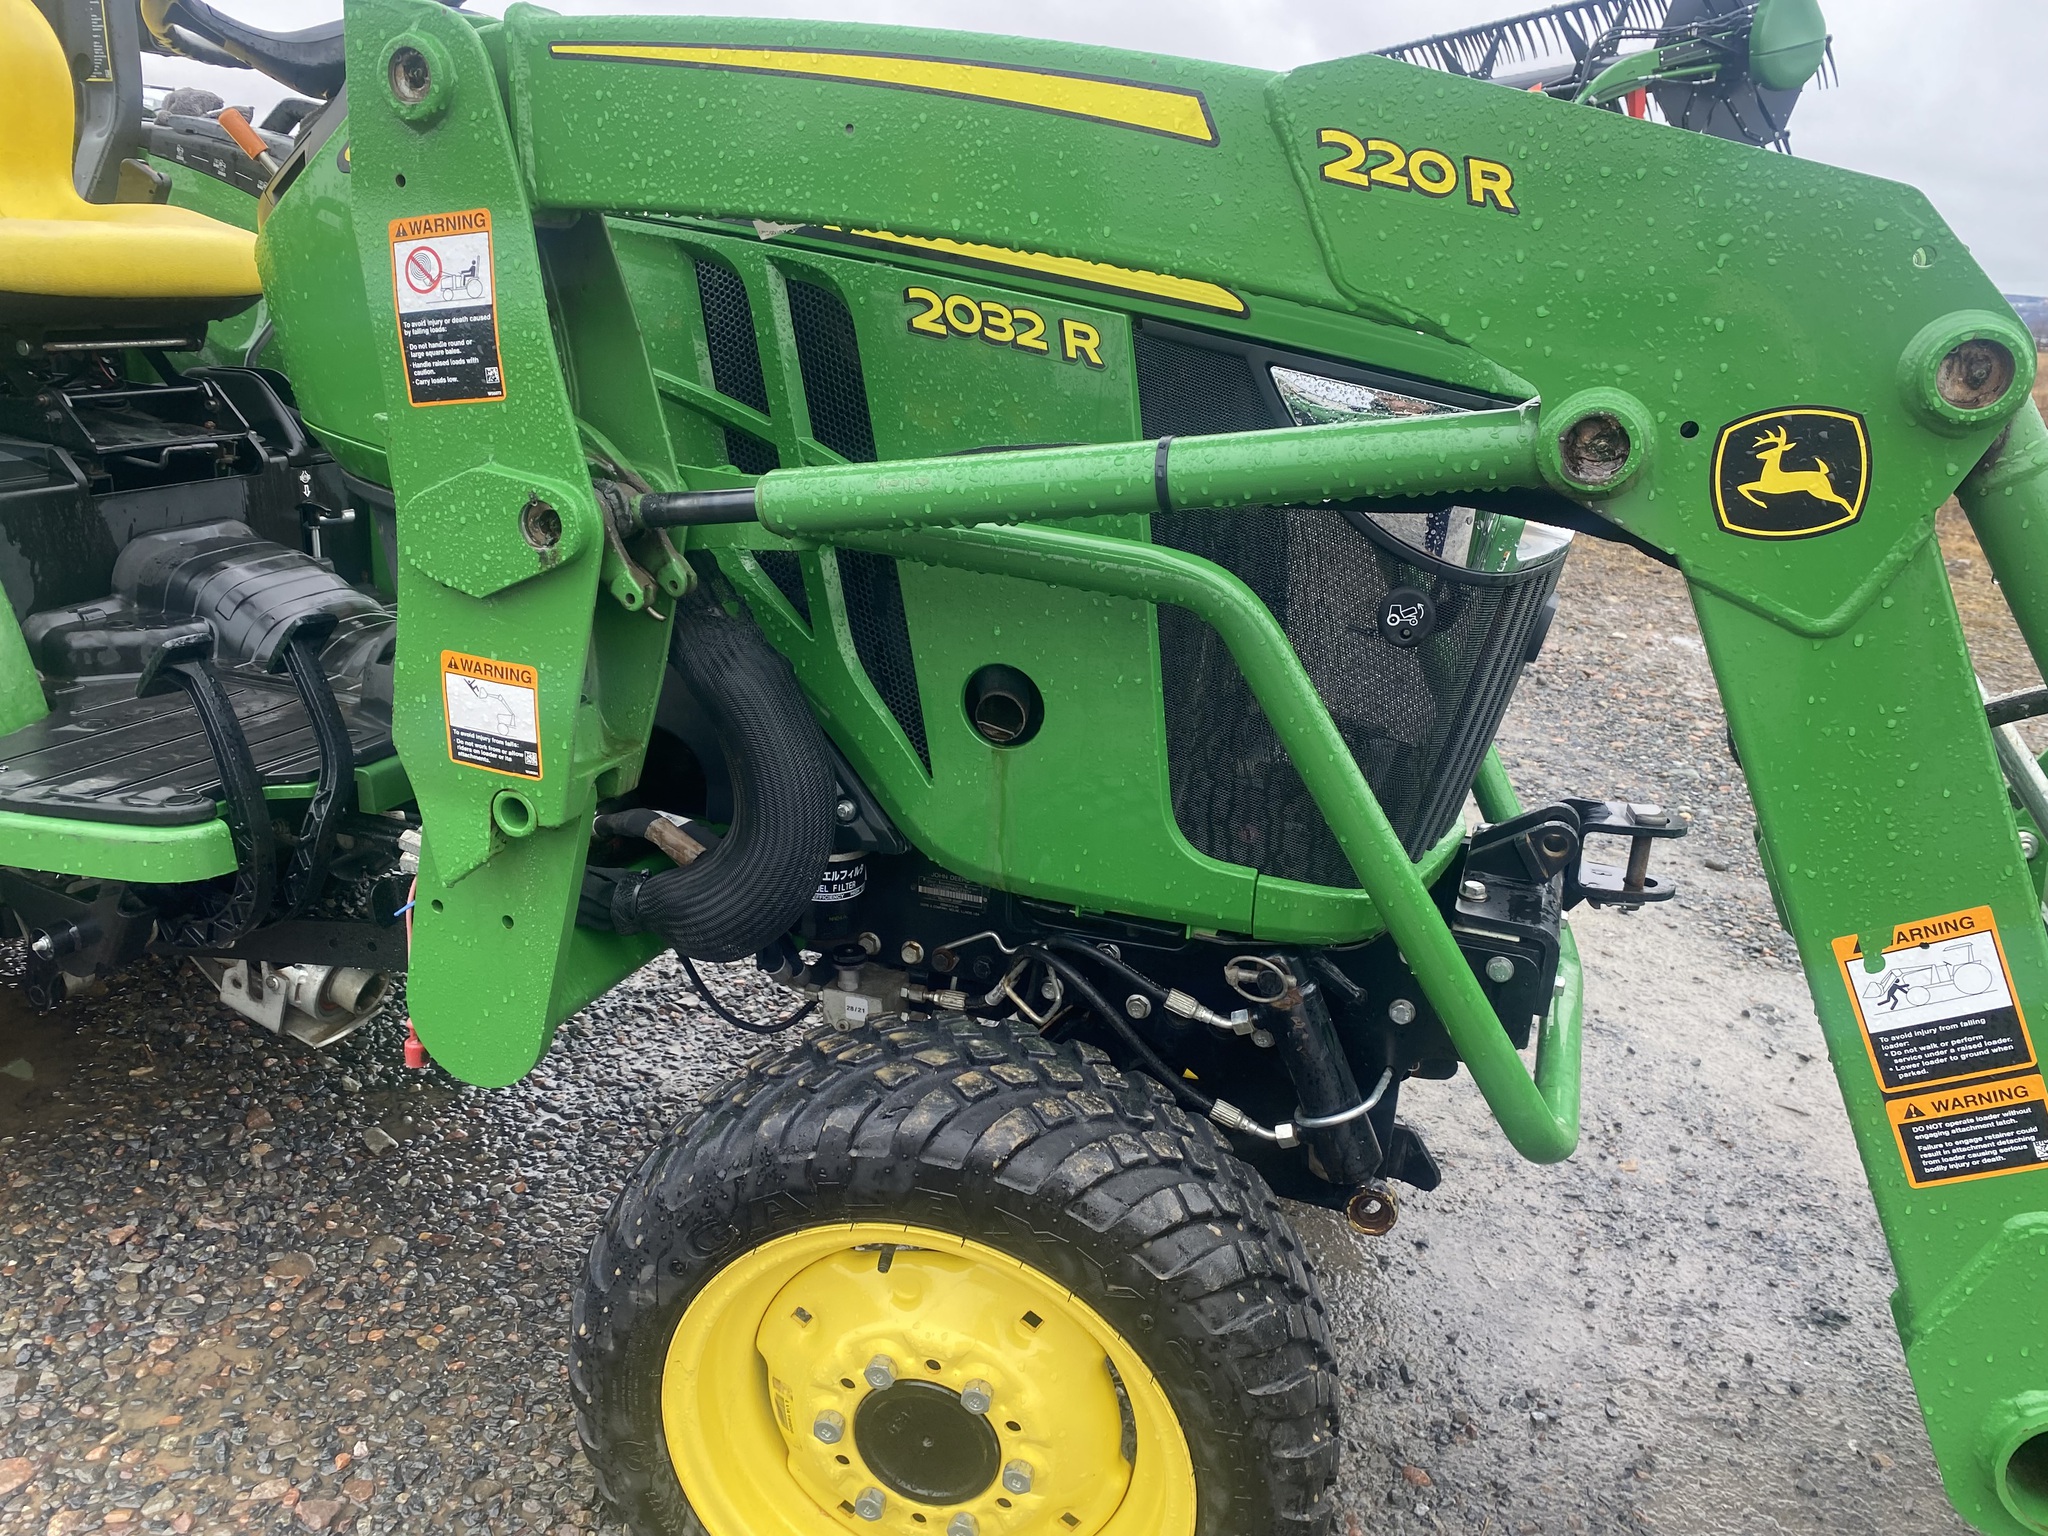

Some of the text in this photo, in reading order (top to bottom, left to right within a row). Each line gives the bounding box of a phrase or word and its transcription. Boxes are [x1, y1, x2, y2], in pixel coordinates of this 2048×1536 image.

[1317, 128, 1519, 216] 220 R
[409, 213, 486, 235] WARNING
[411, 319, 426, 327] avoid
[427, 319, 443, 327] injury
[470, 313, 491, 321] caused
[903, 286, 1107, 370] 2032 R
[404, 329, 411, 337] by
[432, 359, 449, 367] raised
[460, 658, 532, 684] WARNING
[460, 731, 475, 739] avoid
[476, 734, 491, 743] injury
[492, 737, 505, 745] from
[488, 745, 501, 753] from
[508, 750, 524, 758] allow
[822, 864, 864, 881] エルフィルタ
[833, 880, 856, 892] FILTER
[1891, 916, 1975, 946] ARNING
[1890, 1031, 1913, 1041] avoid
[1914, 1028, 1937, 1037] injury
[1938, 1024, 1959, 1032] from
[1960, 1018, 1986, 1028] falling
[1881, 1041, 1910, 1051] loader:
[1893, 1054, 1923, 1064] service
[1924, 1048, 1948, 1058] under
[1956, 1042, 1983, 1052] raised
[1984, 1037, 2013, 1046] loader.
[1903, 1046, 1918, 1054] not
[1919, 1043, 1939, 1051] walk
[1950, 1034, 1984, 1047] perform
[1895, 1062, 1920, 1071] Lower
[1921, 1057, 1948, 1066] loader
[1959, 1048, 1990, 1060] ground
[1990, 1044, 2014, 1053] when
[1898, 1068, 1929, 1080] parked.
[1931, 1085, 2029, 1113] WARNING
[1911, 1107, 2032, 1133] DO NOT operate loader without
[1914, 1118, 2018, 1140] engaging attachment latch.
[1917, 1143, 1944, 1152] Failure
[1954, 1136, 1984, 1145] engage
[1984, 1131, 2015, 1140] retainer
[2016, 1126, 2038, 1135] could
[1920, 1149, 1943, 1159] result
[1951, 1141, 1996, 1154] attachment
[1996, 1135, 2036, 1146] detaching
[1922, 1145, 2028, 1166] from loader causing serious
[1924, 1164, 1948, 1173] bodily
[1948, 1161, 1971, 1169] injury
[1981, 1155, 2007, 1164] death.
